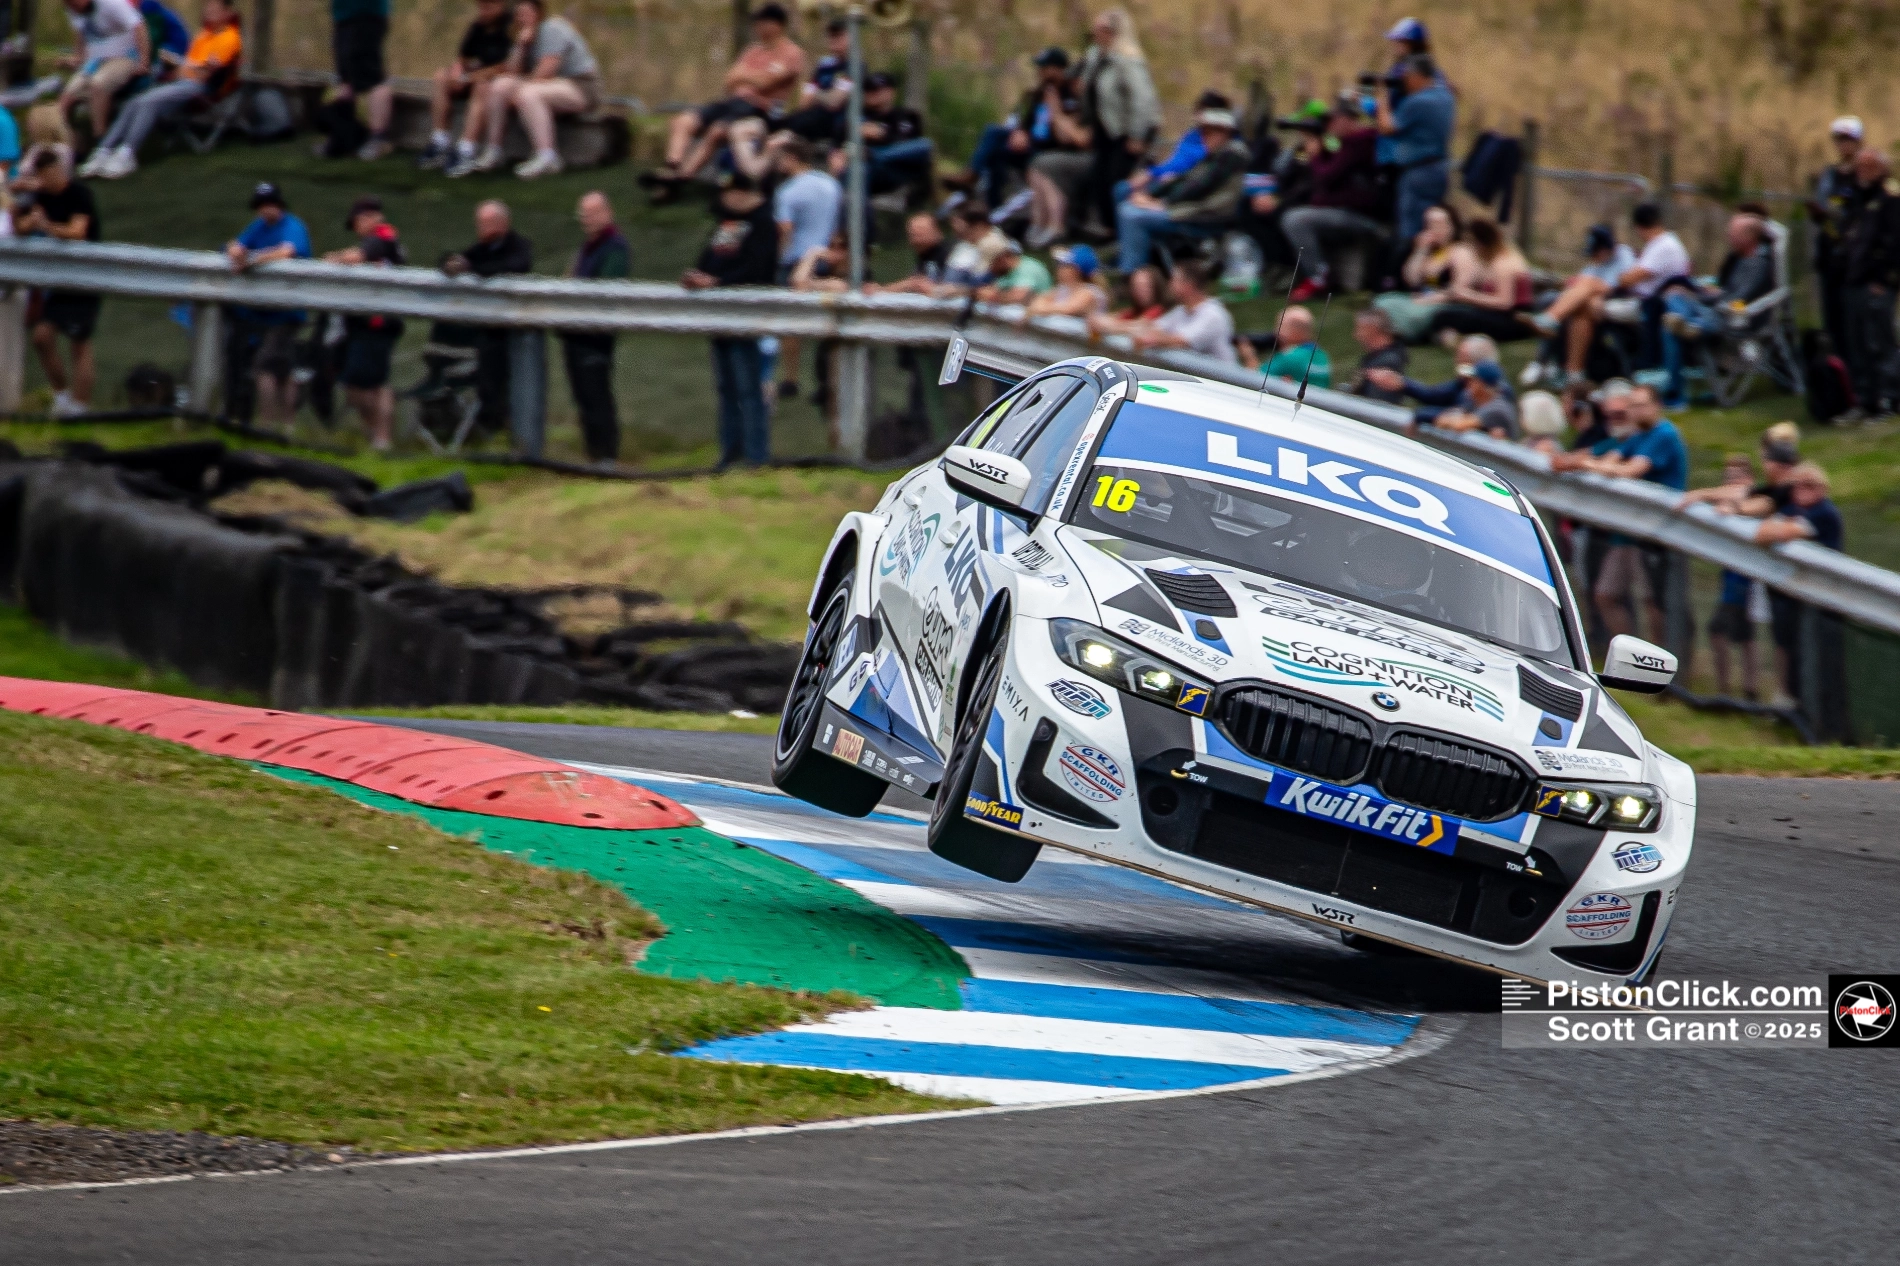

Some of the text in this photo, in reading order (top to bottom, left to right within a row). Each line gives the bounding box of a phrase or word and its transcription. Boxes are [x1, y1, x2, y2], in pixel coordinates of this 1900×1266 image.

[969, 458, 1009, 482] WSR
[1206, 430, 1456, 536] LKQ
[1092, 475, 1141, 512] 16
[1150, 627, 1229, 666] Midlands 3D
[1290, 641, 1474, 701] COGNITION
[1632, 653, 1666, 670] WSR
[1293, 652, 1364, 676] LAND
[1390, 676, 1476, 712] WATER
[1061, 751, 1123, 797] SCAFFOLDING
[1081, 747, 1119, 776] GKR
[1066, 771, 1104, 799] LIMITED
[1189, 772, 1209, 784] TOW
[1506, 861, 1524, 872] TOW
[1312, 903, 1355, 925] WSR
[1581, 894, 1621, 906] GKR
[1566, 910, 1632, 923] SCAFFOLDING
